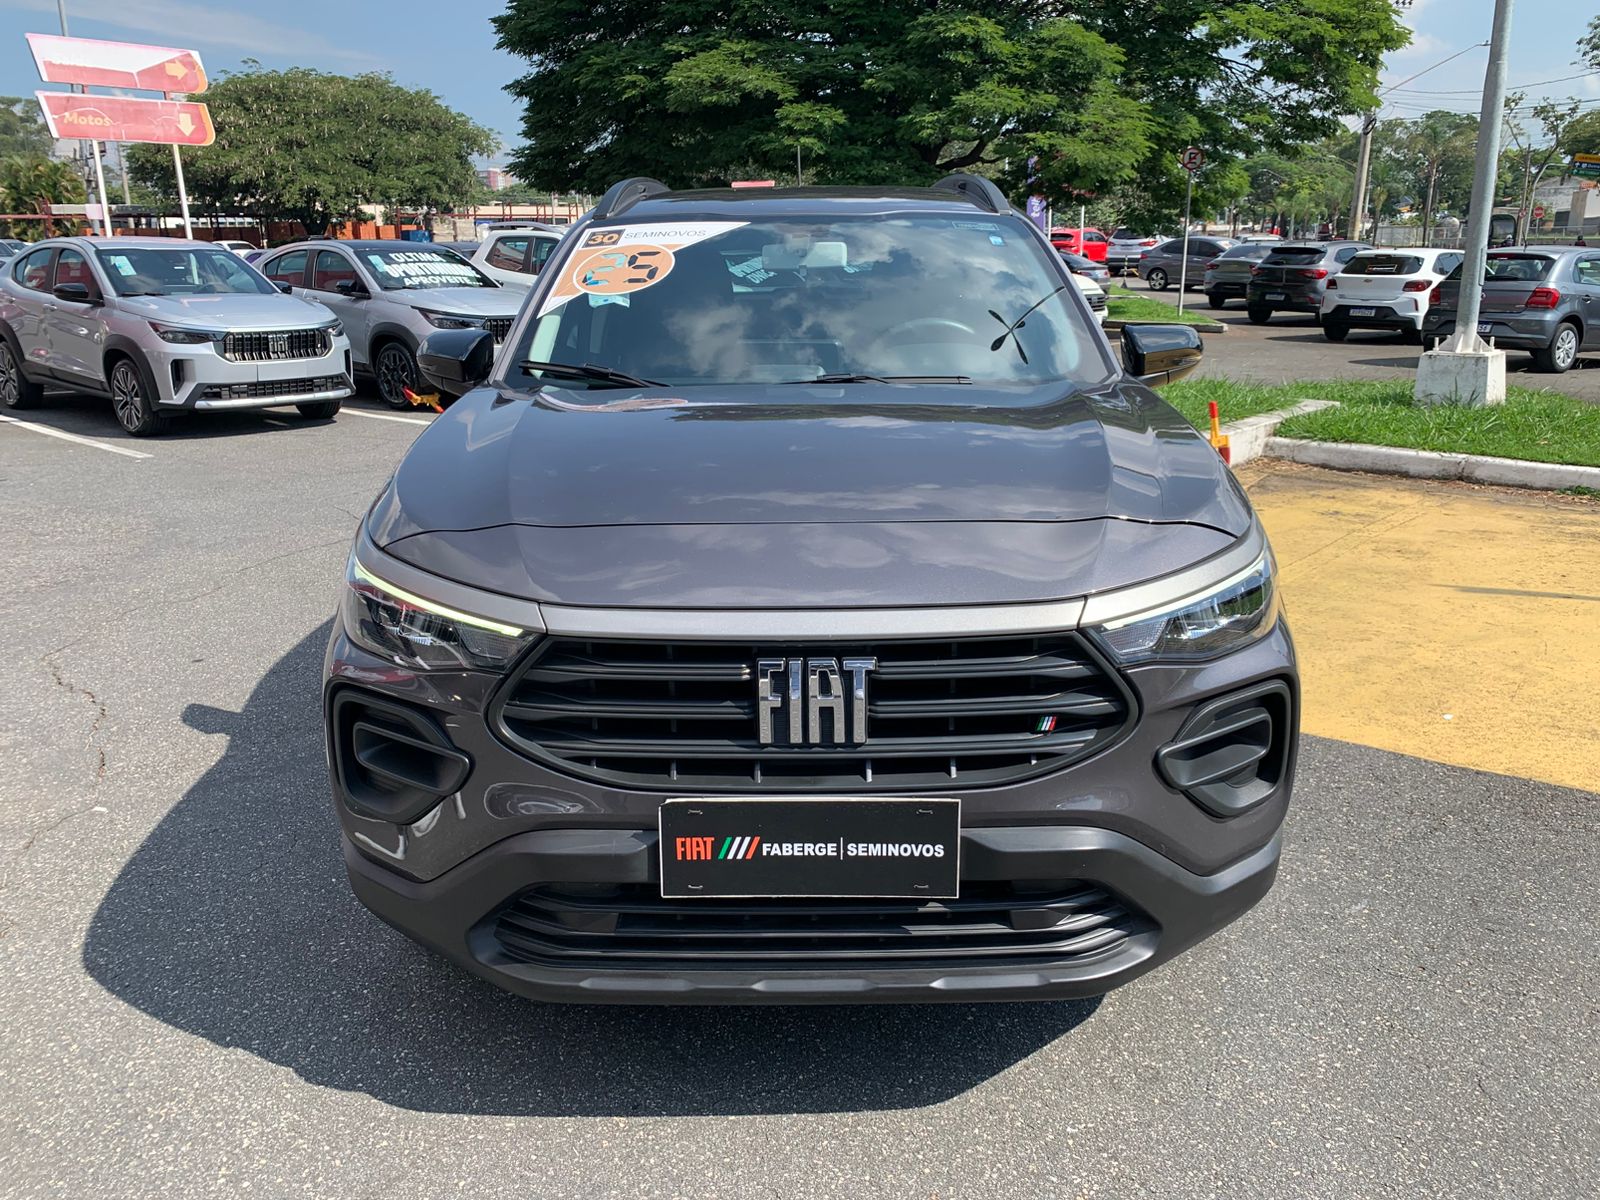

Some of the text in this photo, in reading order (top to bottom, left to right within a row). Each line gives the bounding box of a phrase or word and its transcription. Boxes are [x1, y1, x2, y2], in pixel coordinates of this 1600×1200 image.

[63, 112, 111, 127] Motos
[588, 229, 707, 245] 30 SEMINOVOS
[268, 334, 289, 353] FIAT
[757, 657, 877, 744] FIAT
[676, 837, 945, 860] FIAT FABERGE SEMINOVOS
